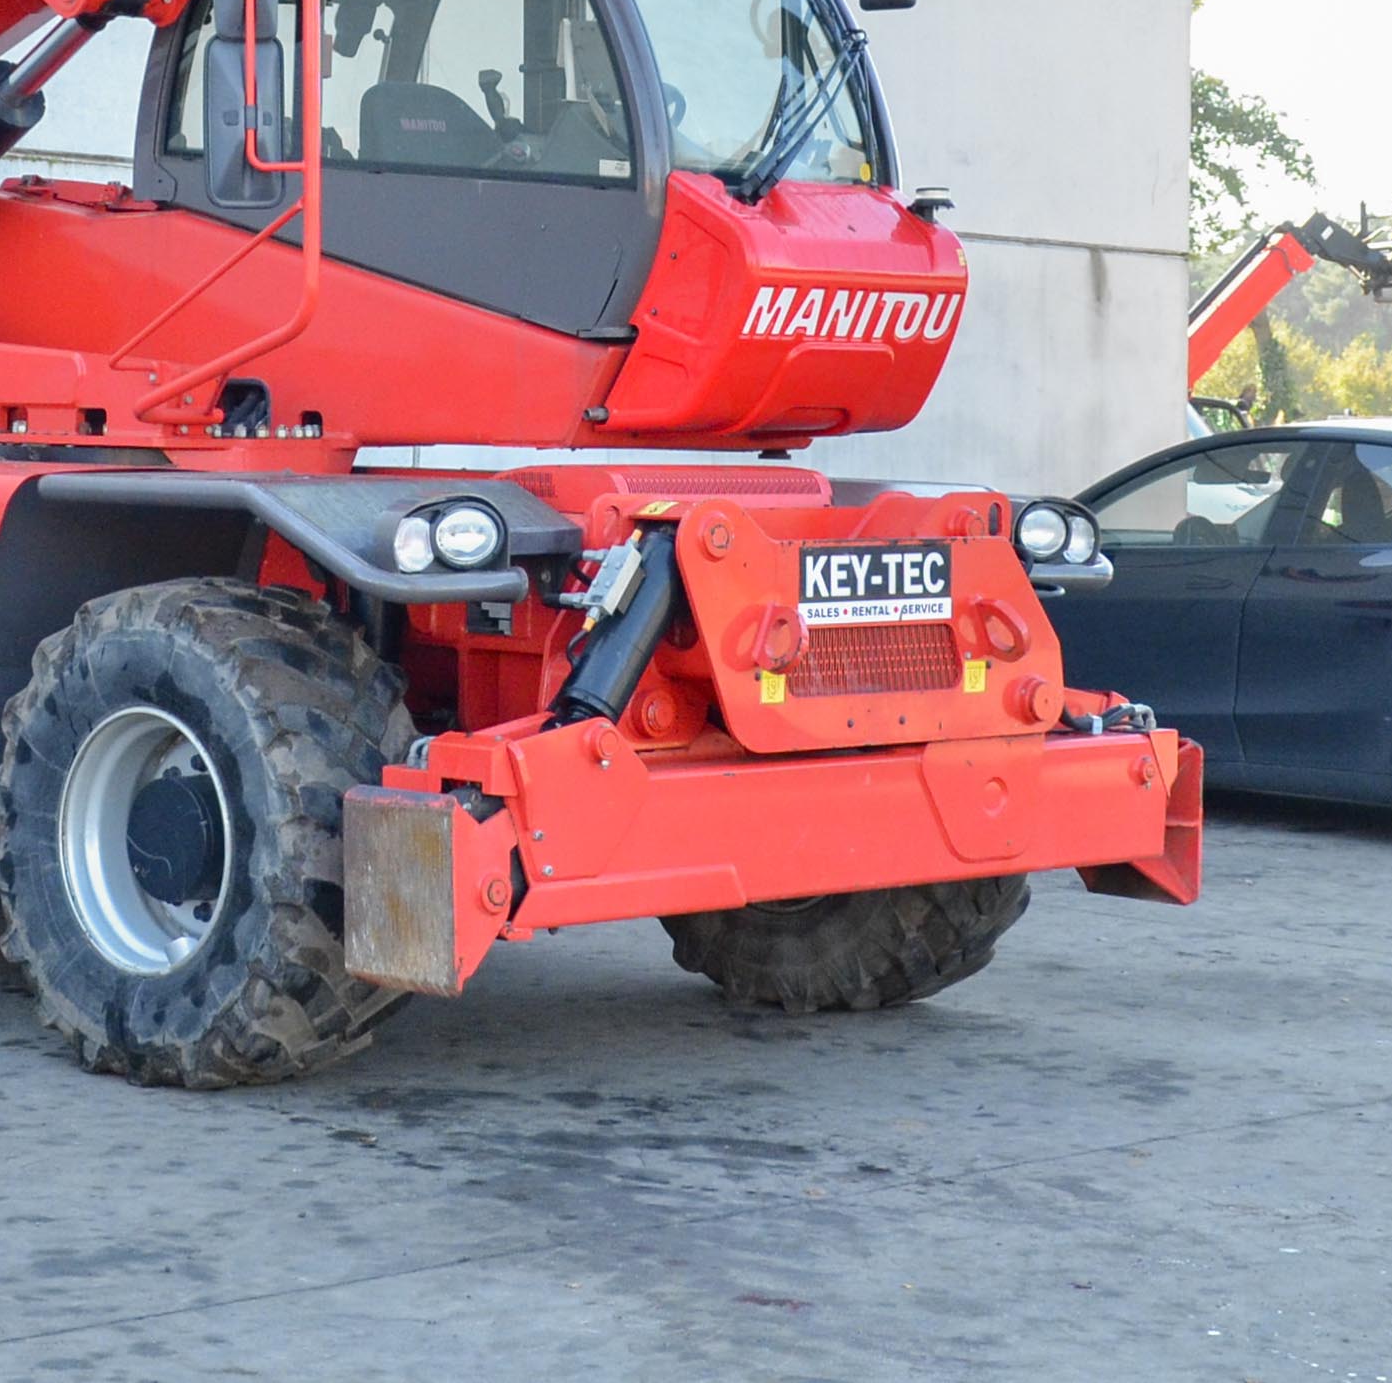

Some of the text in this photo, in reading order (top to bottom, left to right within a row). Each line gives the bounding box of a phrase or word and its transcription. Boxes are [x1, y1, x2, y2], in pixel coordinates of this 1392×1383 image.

[741, 286, 962, 340] MANITOU
[805, 552, 945, 598] KEY-TEC
[807, 603, 944, 619] SALES RENTAL SERVICE
